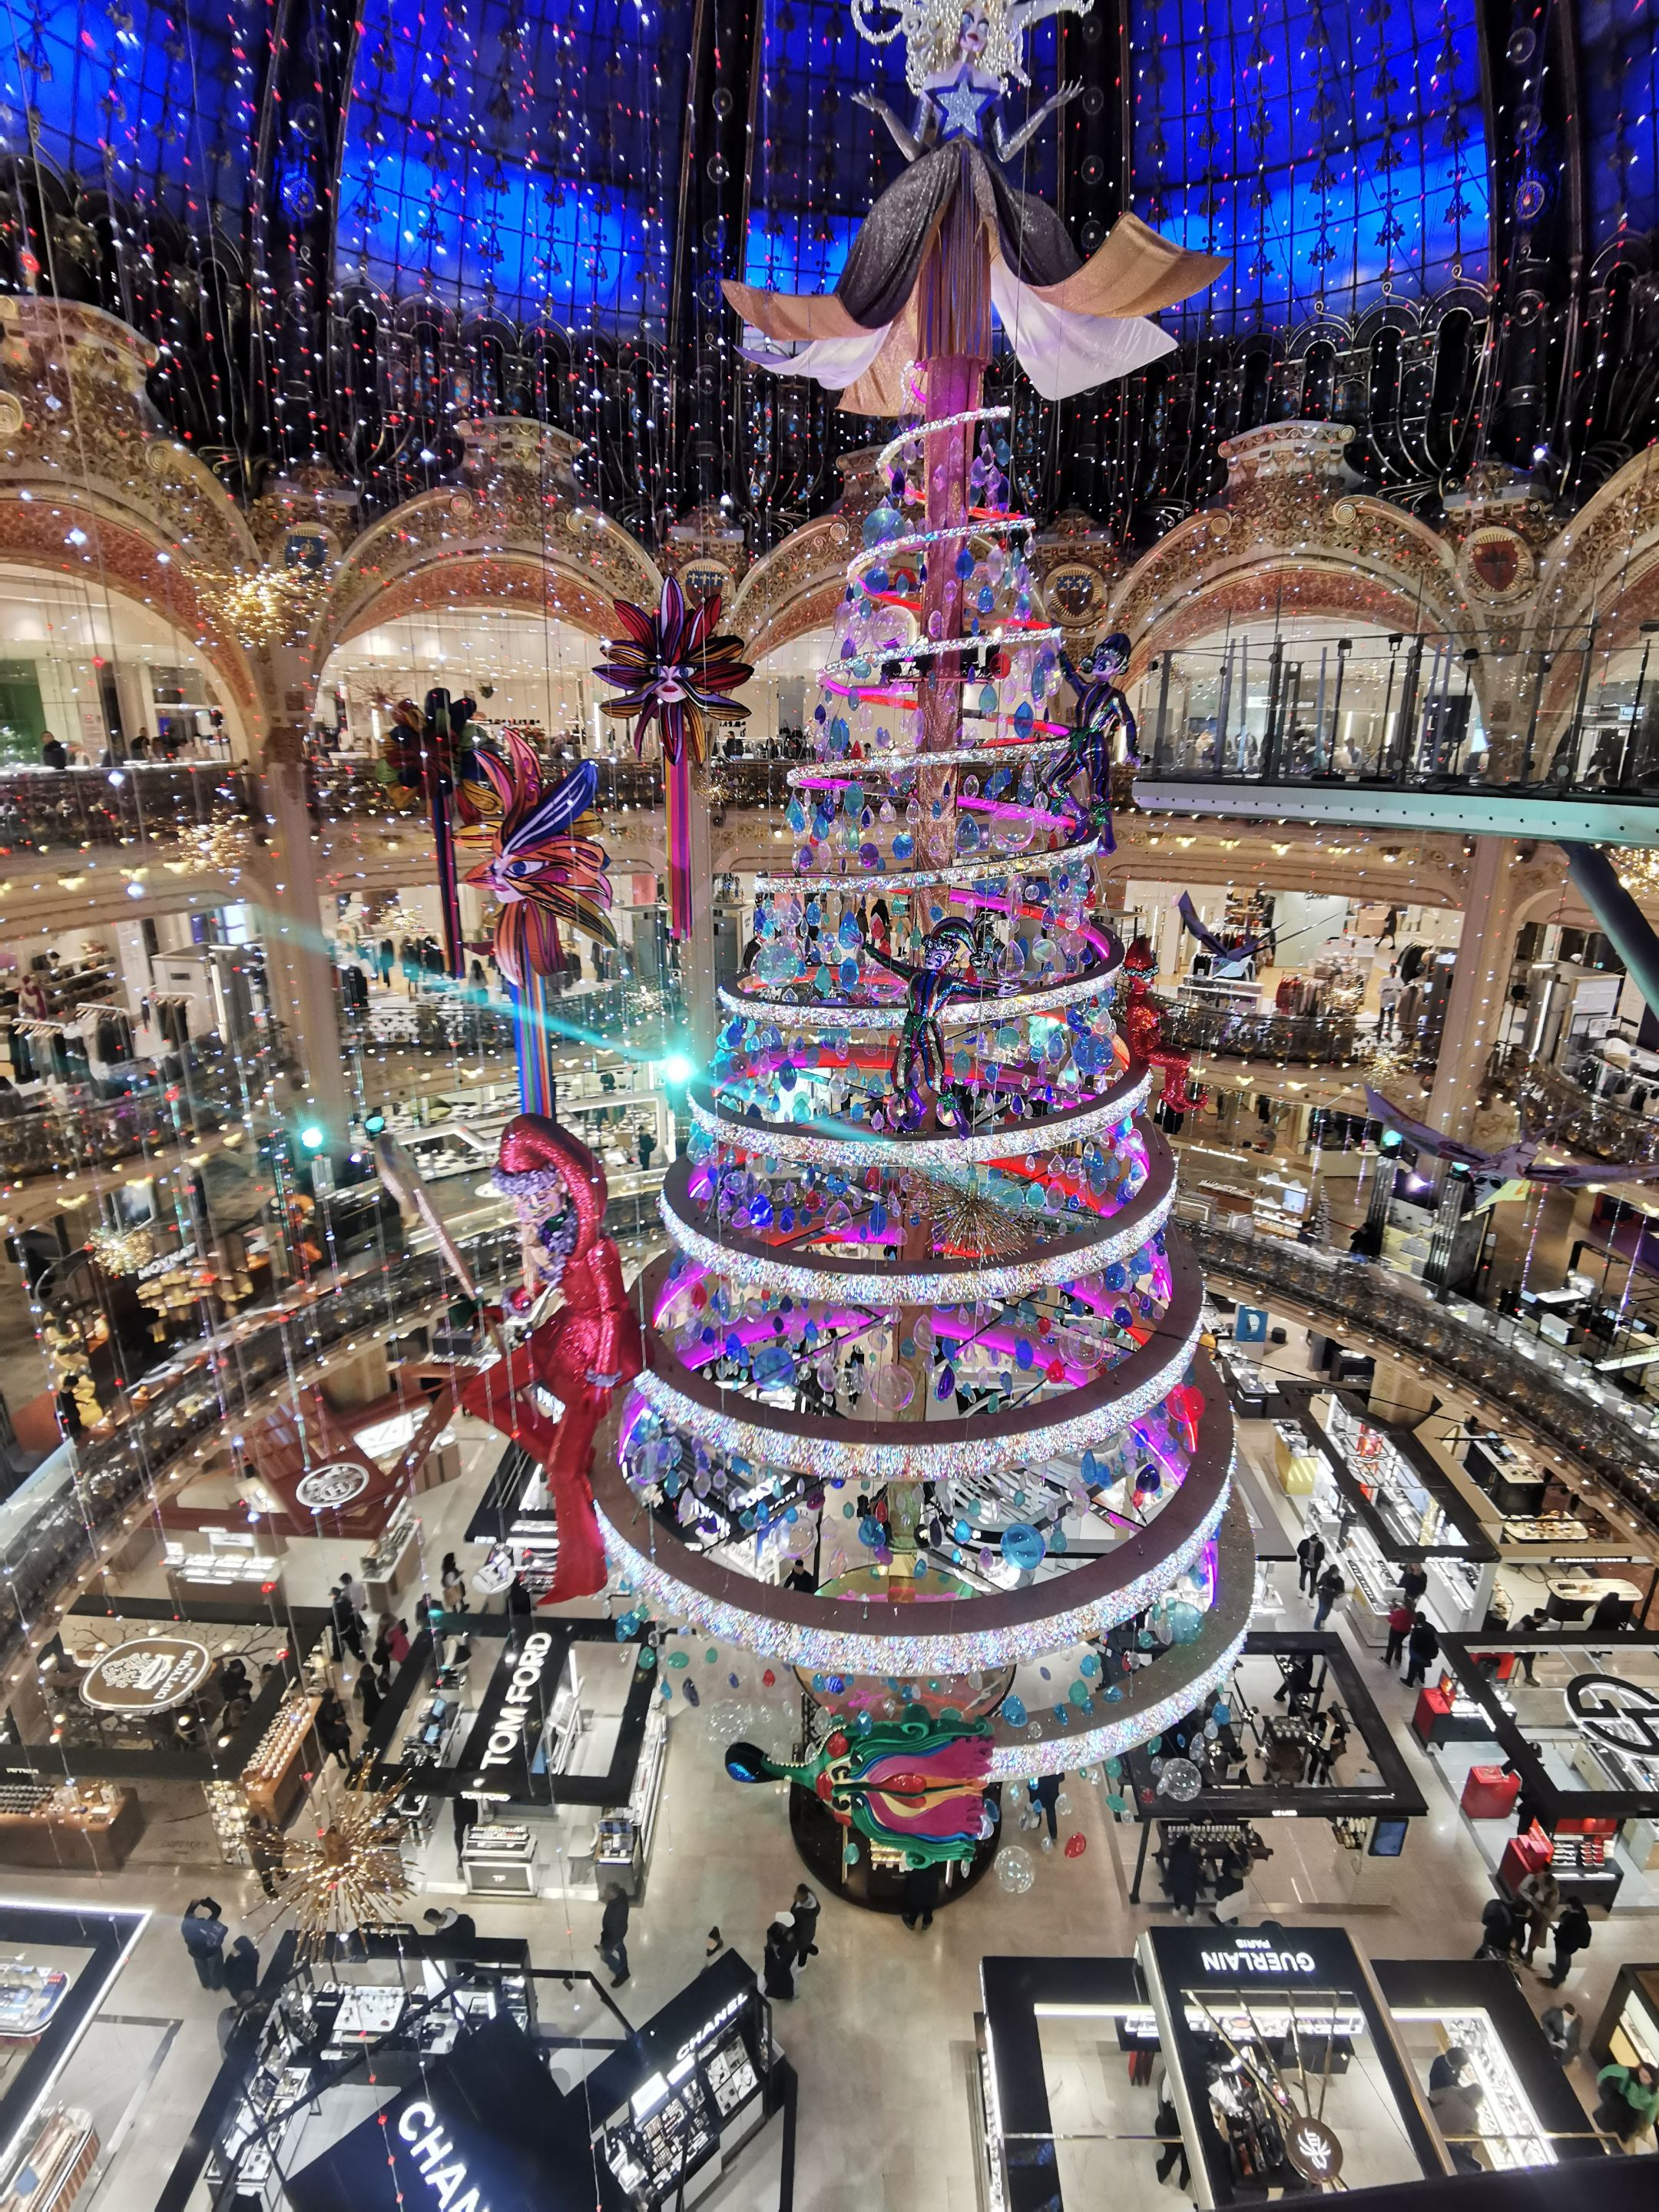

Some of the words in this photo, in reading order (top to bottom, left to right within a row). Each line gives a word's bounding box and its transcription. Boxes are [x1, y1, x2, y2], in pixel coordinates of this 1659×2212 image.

[137, 1242, 196, 1280] MOYNAT
[154, 1650, 199, 1700] DIPTYQUE
[479, 1707, 528, 1770] TOM
[505, 1632, 552, 1704] FORD
[460, 1790, 482, 1800] TOM
[1201, 1951, 1316, 1972] GUERLAIN
[1235, 1939, 1271, 1949] PARIS
[677, 1992, 748, 2061] CHANEL
